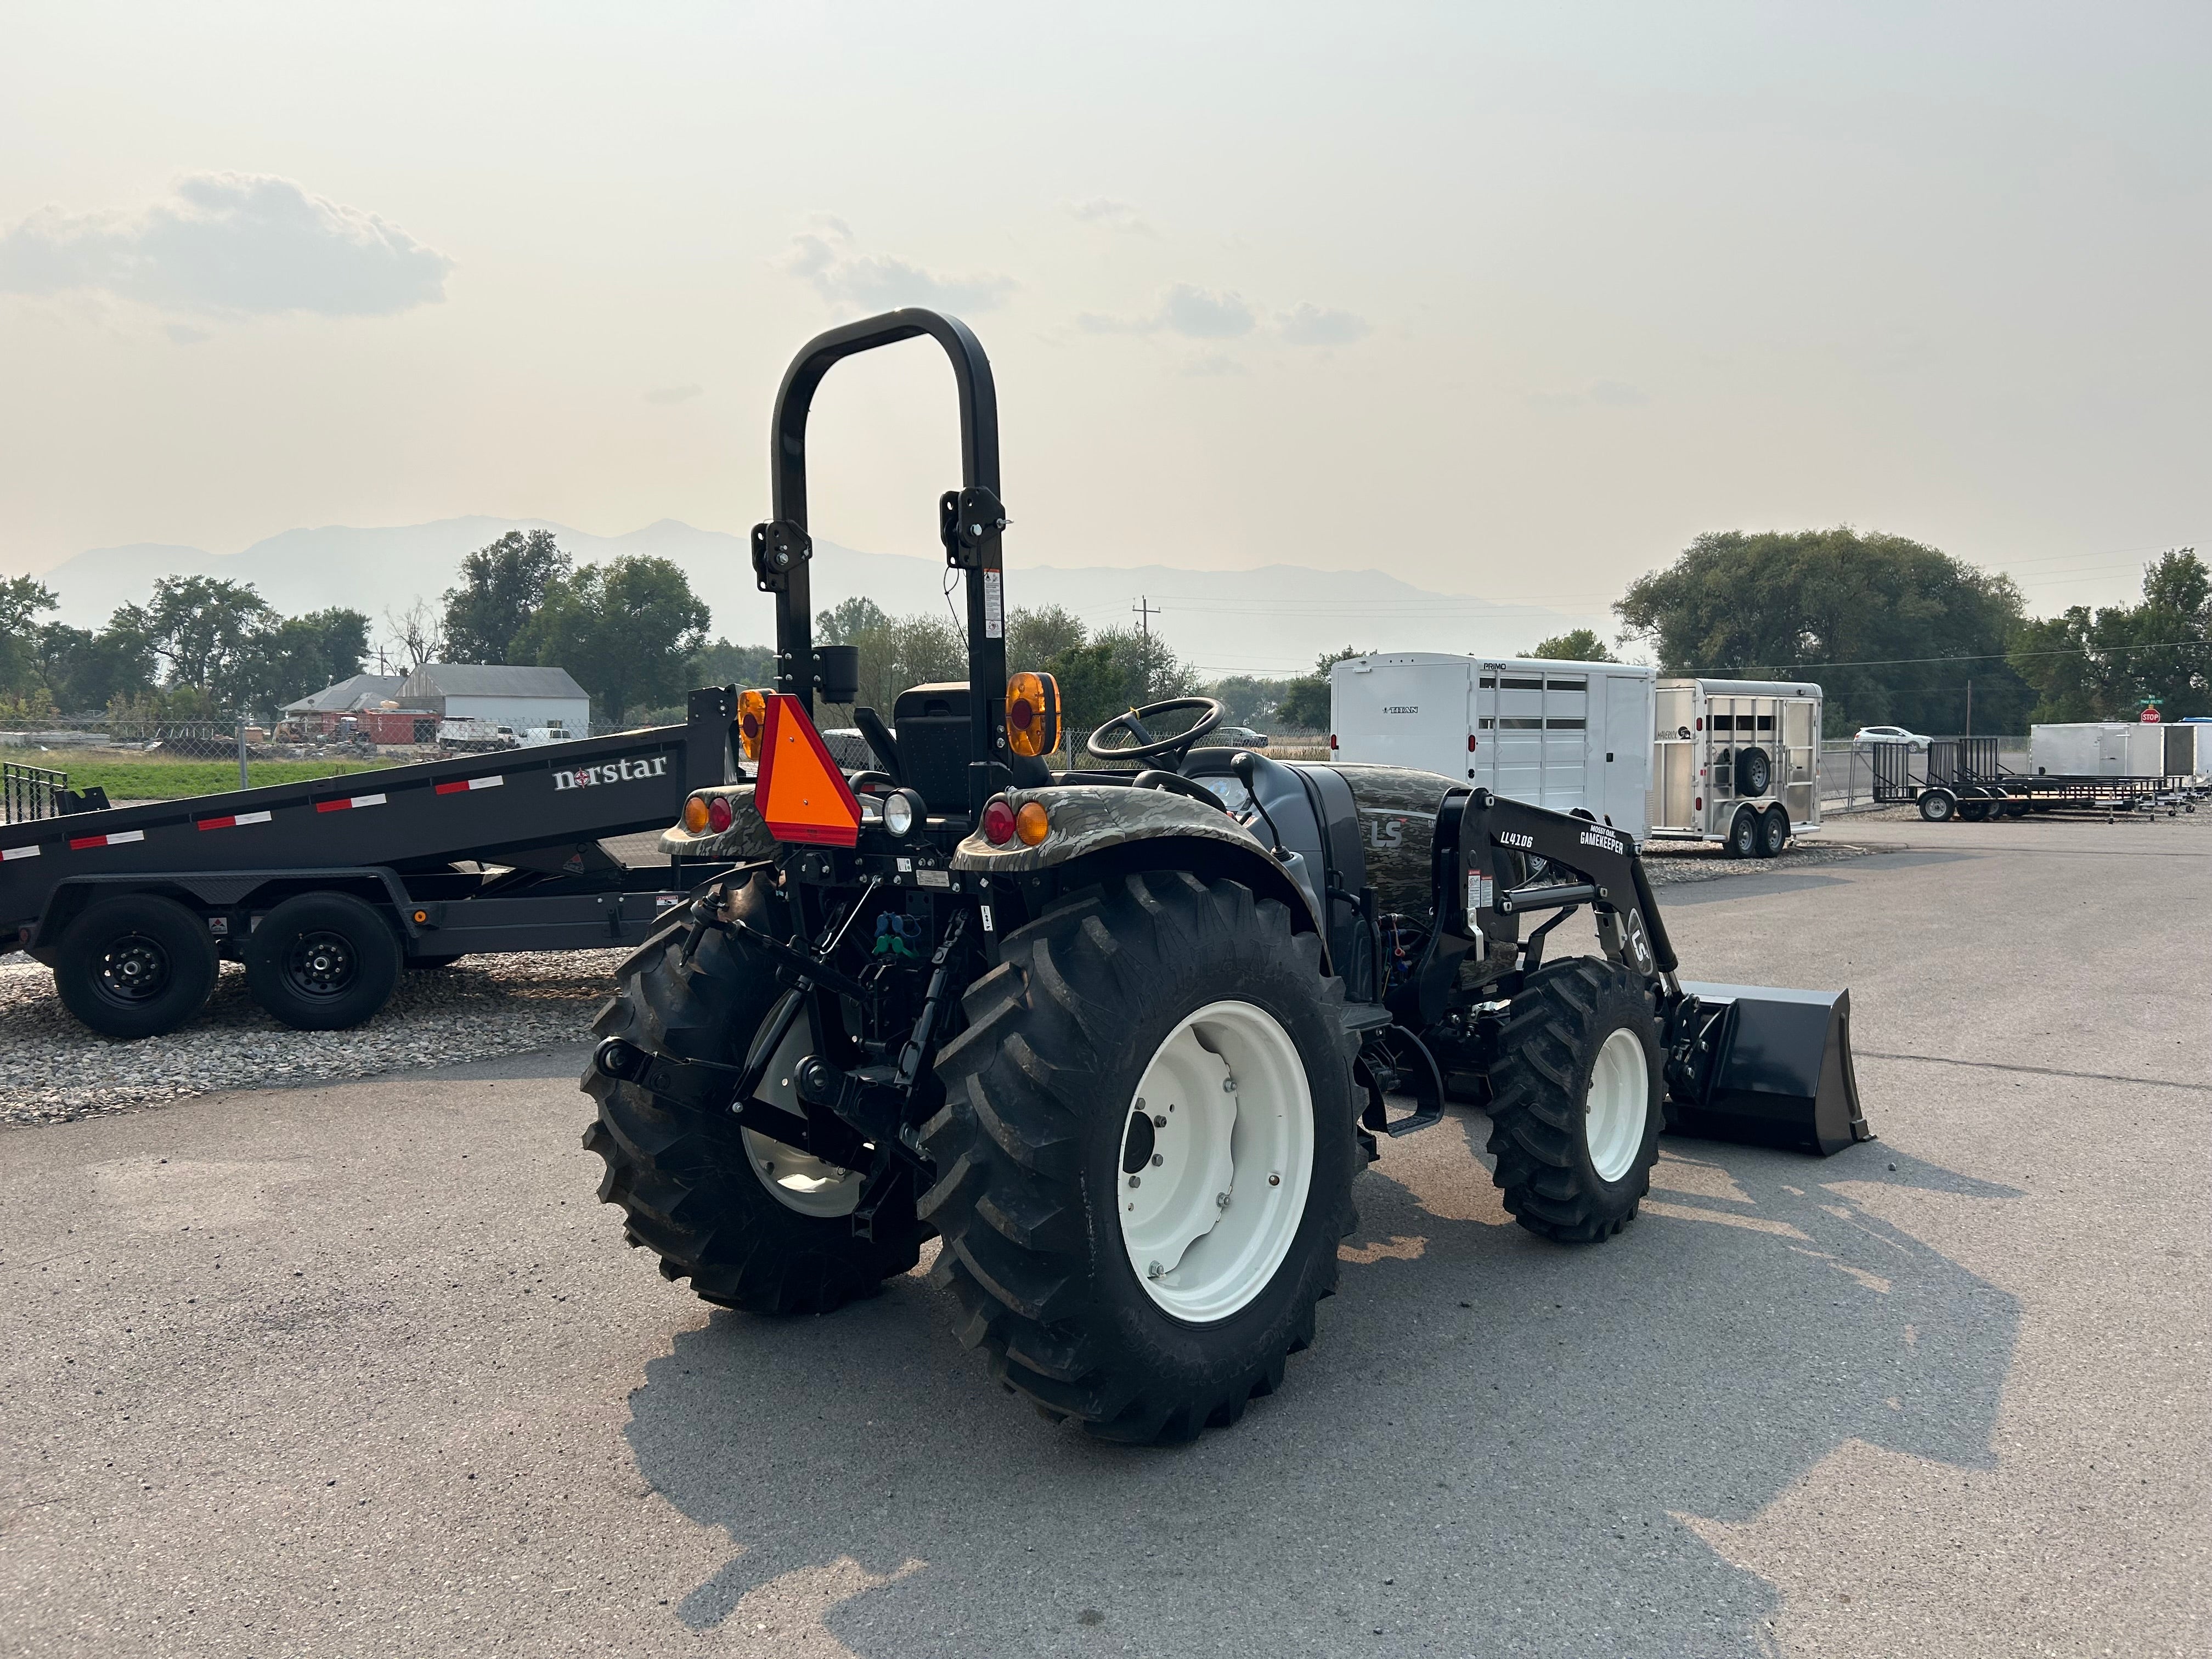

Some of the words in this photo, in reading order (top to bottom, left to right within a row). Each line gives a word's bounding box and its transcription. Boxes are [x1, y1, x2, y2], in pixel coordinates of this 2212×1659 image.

[1657, 731, 1677, 740] MAVERICK
[552, 755, 668, 792] norstar
[1371, 821, 1402, 847] LS
[1500, 831, 1533, 848] LL4106
[1590, 825, 1607, 835] MOSSY
[1580, 831, 1624, 855] GAMEKEEPER
[1632, 929, 1647, 962] LS
